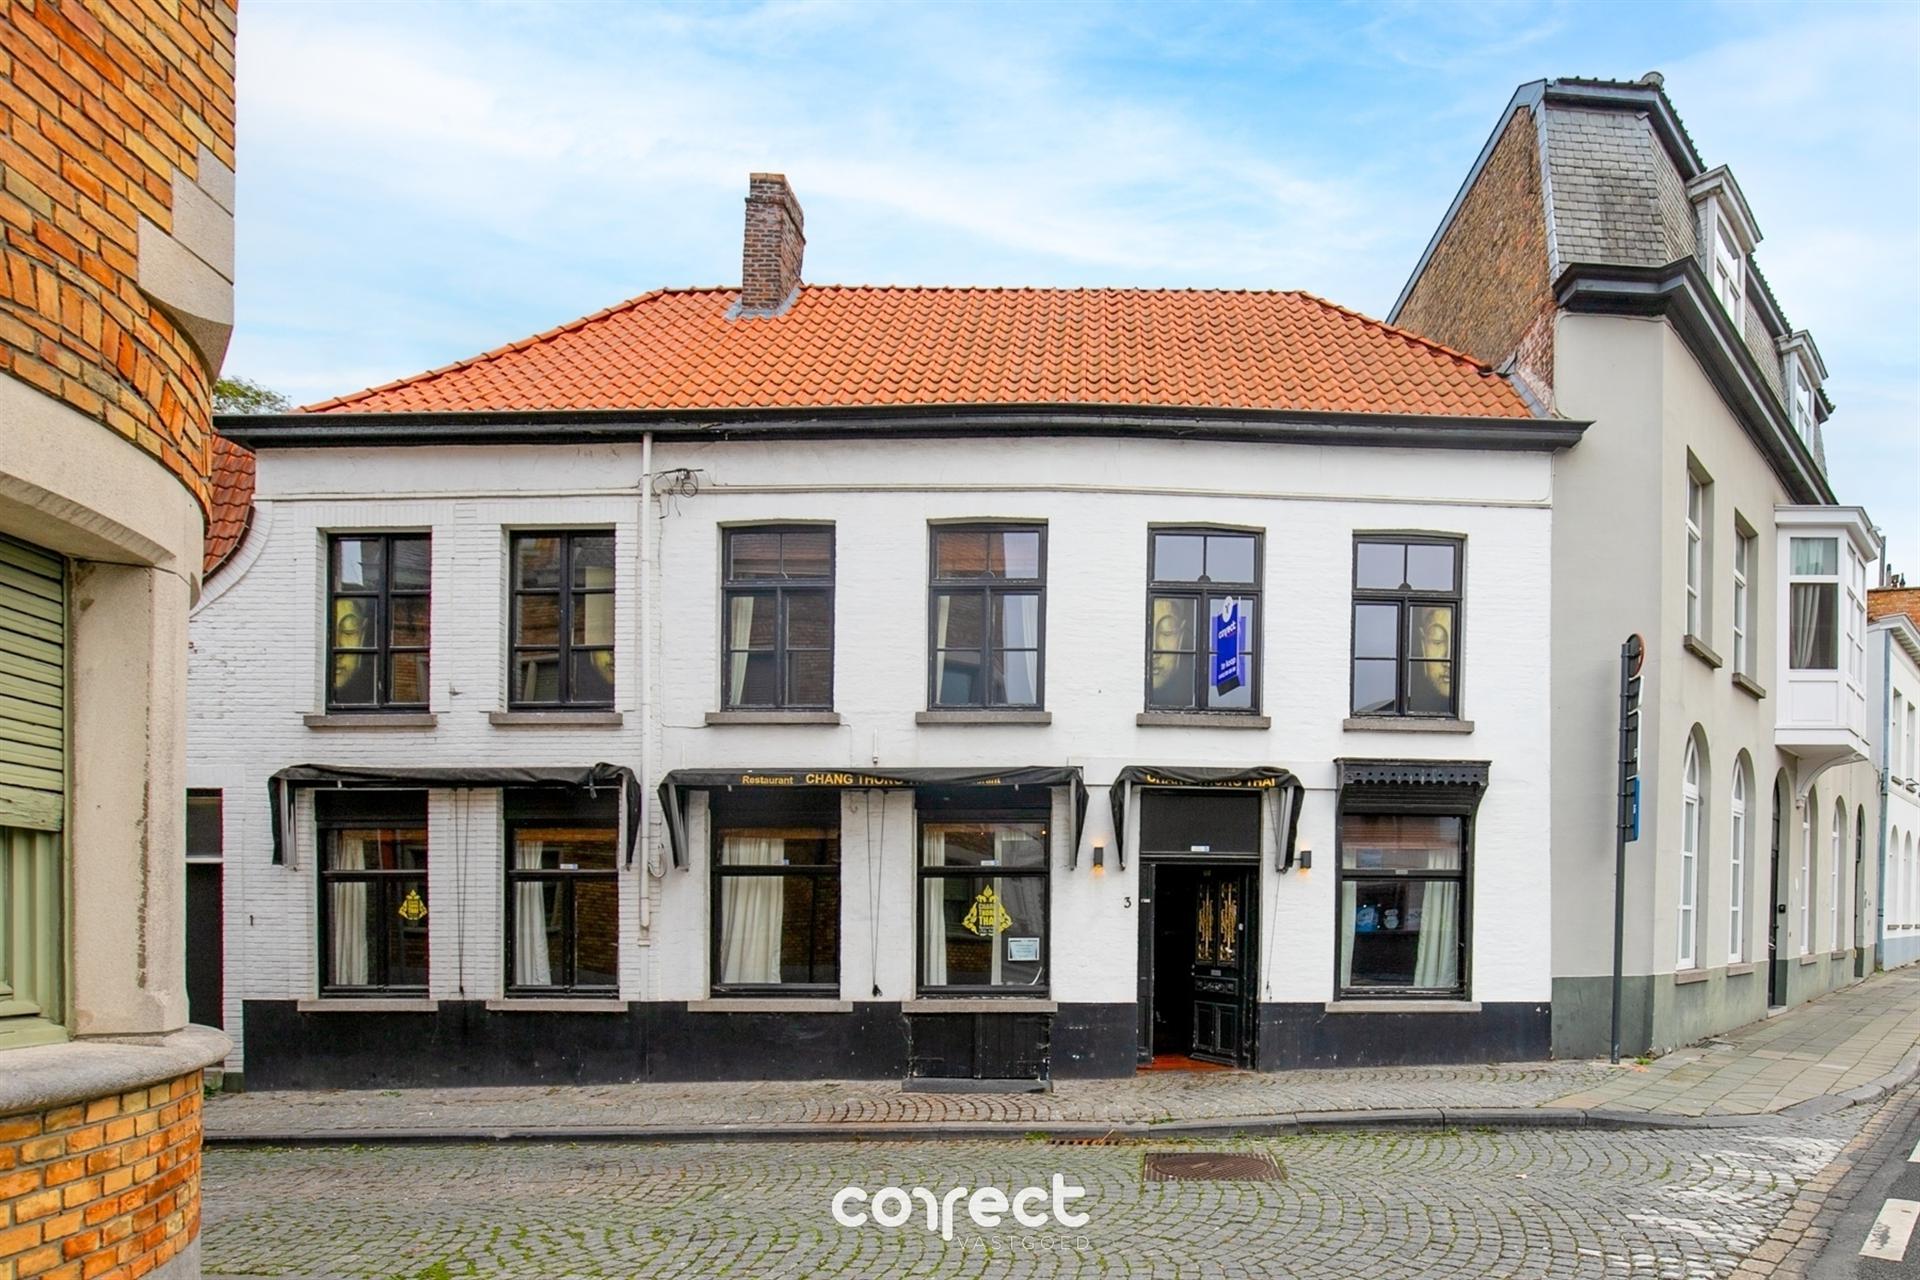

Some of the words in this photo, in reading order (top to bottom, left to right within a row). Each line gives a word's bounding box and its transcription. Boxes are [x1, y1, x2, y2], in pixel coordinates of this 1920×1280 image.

[742, 775, 794, 785] Restaurant
[805, 773, 853, 785] CHANG
[1124, 896, 1132, 908] 3
